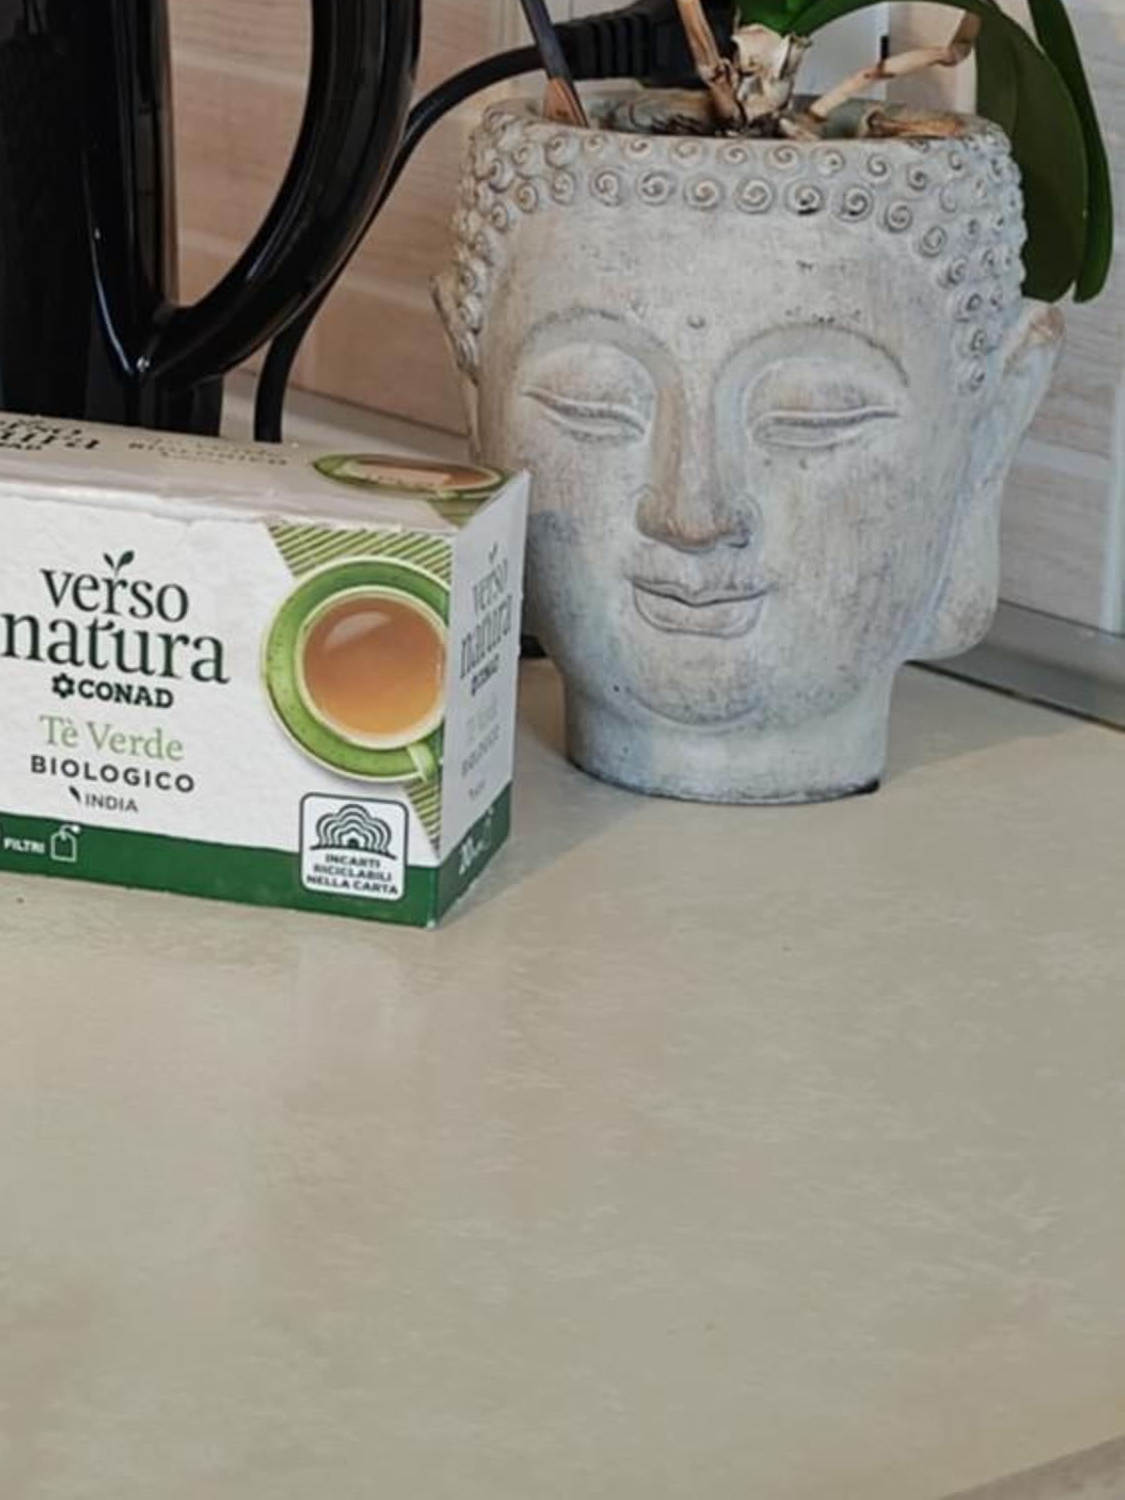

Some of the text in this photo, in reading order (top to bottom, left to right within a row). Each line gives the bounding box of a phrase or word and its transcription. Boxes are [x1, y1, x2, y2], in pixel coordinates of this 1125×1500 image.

[39, 567, 190, 624] verso
[0, 612, 232, 686] natura
[77, 678, 175, 710] CONAD
[38, 714, 185, 762] Tè Verde
[30, 754, 196, 794] BIOLOGICO
[84, 793, 140, 814] INDIA
[3, 836, 46, 855] FILTRI
[325, 853, 381, 869] INCARTI
[306, 874, 399, 895] NELLA CARTA
